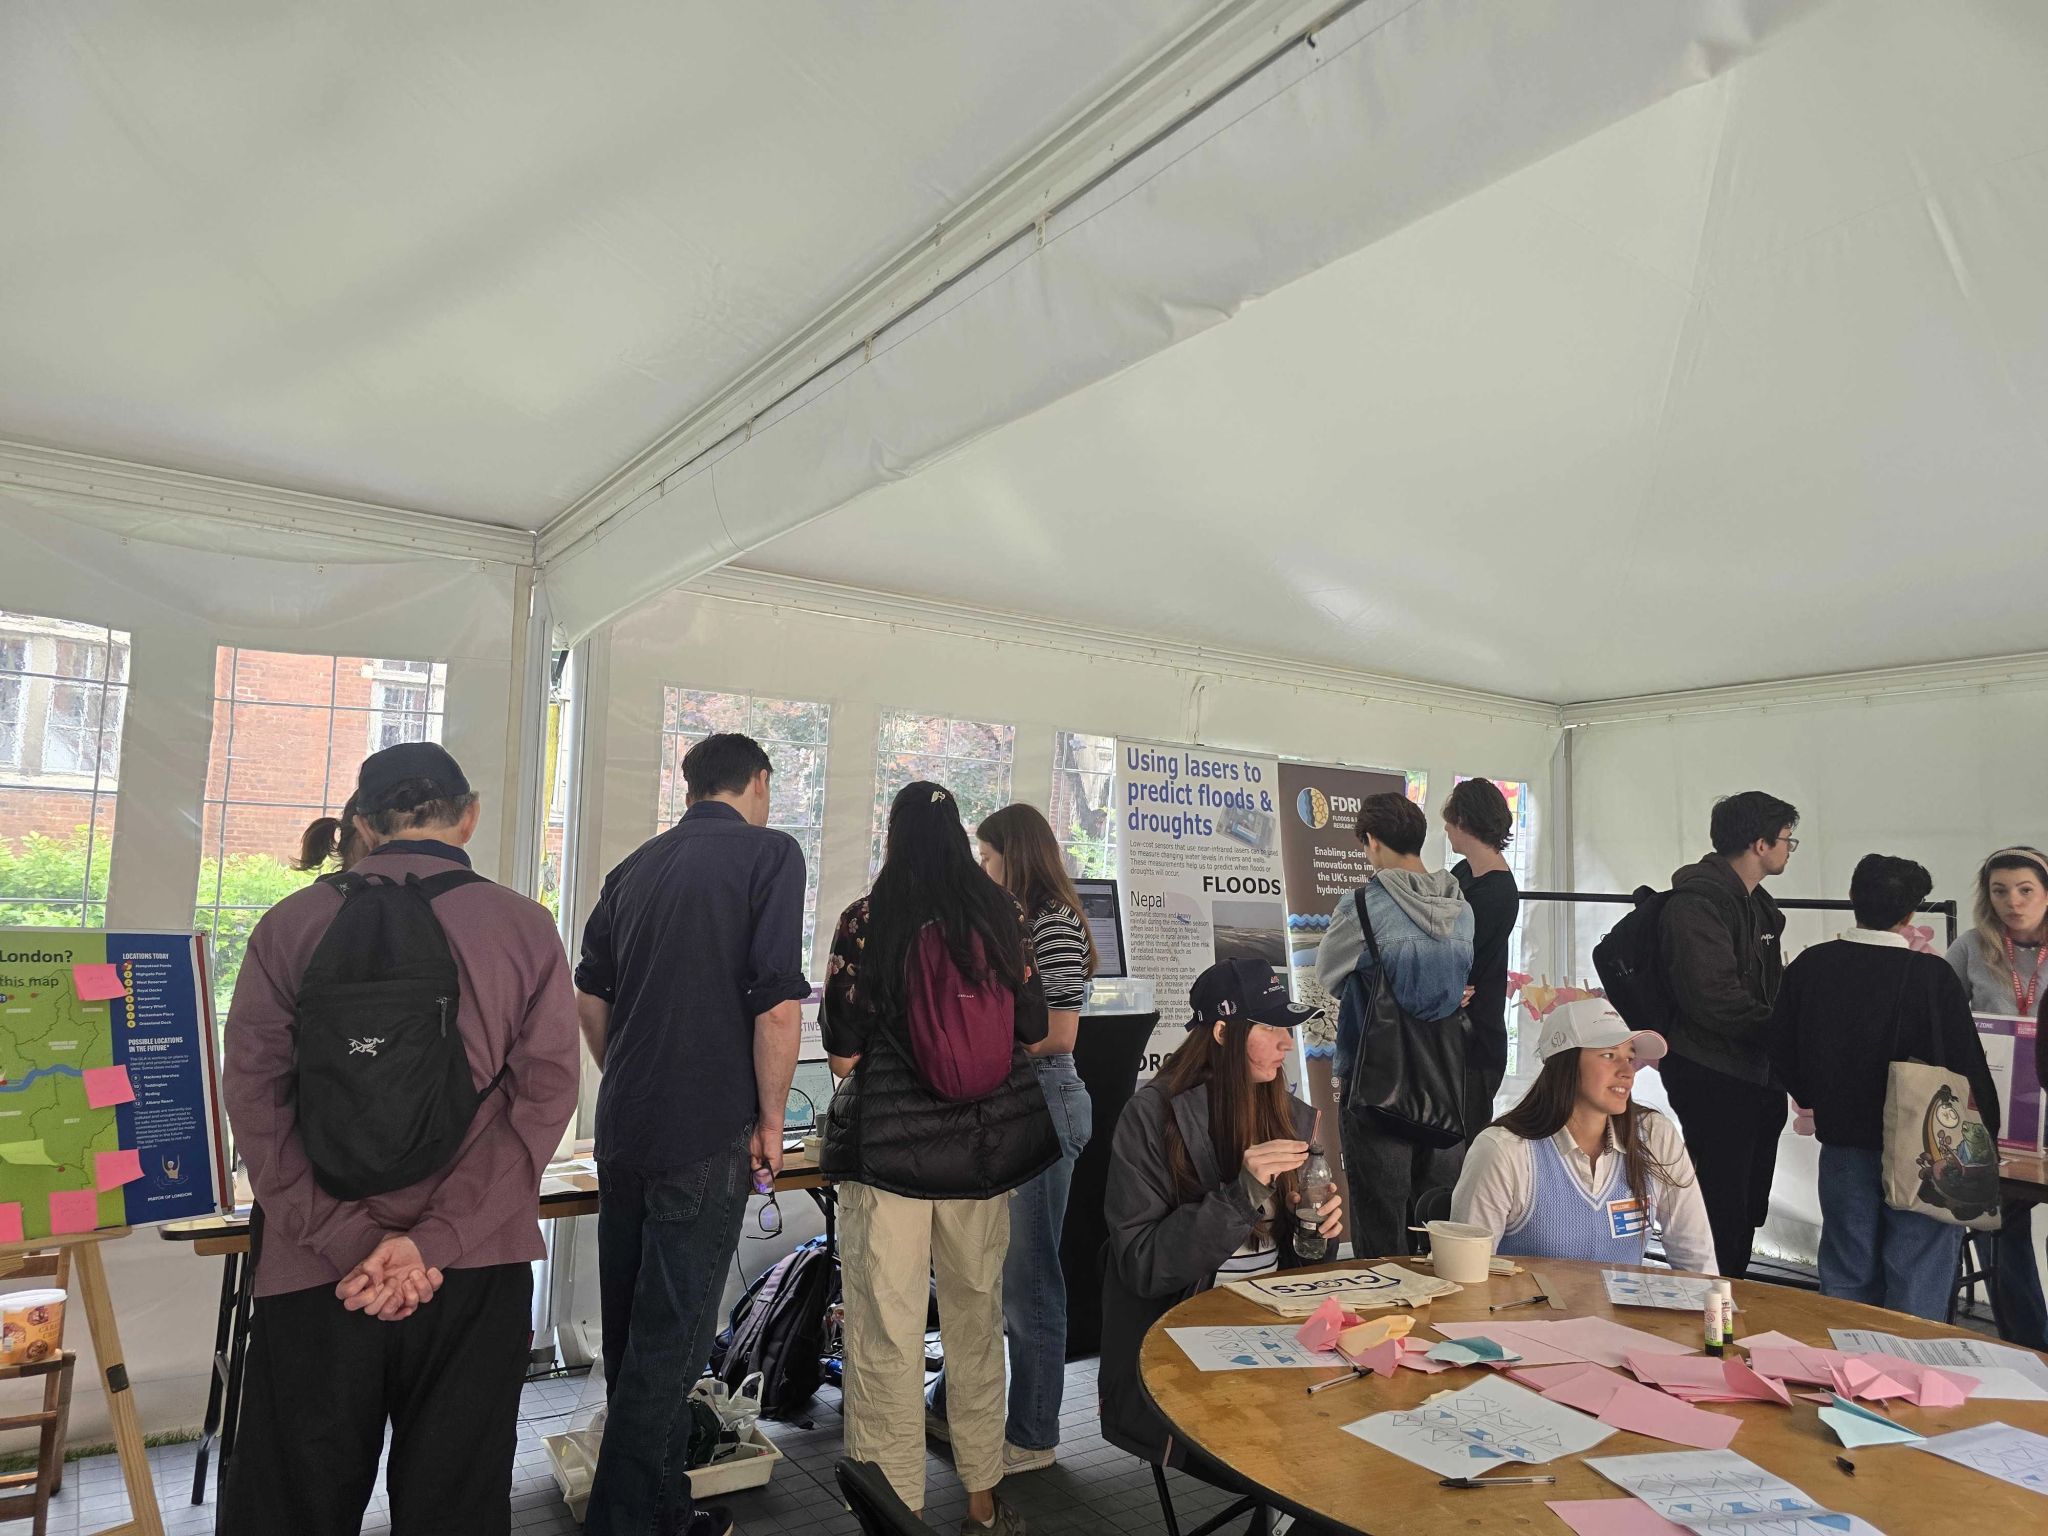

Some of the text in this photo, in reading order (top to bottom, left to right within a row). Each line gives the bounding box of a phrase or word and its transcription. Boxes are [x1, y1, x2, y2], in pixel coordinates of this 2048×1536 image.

[1127, 747, 1262, 783] Using lasers to
[1127, 780, 1274, 812] predict floods &
[1127, 807, 1213, 839] droughts
[1130, 840, 1154, 848] Low-cost
[1198, 845, 1233, 853] near-infrared
[1315, 846, 1367, 859] Enabling scien
[1161, 851, 1184, 860] changing
[1130, 858, 1146, 866] These
[1148, 860, 1185, 868] measurements
[1186, 861, 1198, 869] help
[1214, 863, 1233, 871] predict
[1250, 864, 1265, 872] floods
[1313, 859, 1352, 870] innovation
[1354, 862, 1362, 870] to
[1130, 867, 1154, 876] droughts
[1317, 872, 1370, 883] the UK's resili
[1203, 875, 1281, 896] FLOODS
[1130, 891, 1165, 911] Nepal
[1148, 918, 1161, 926] during
[0, 949, 73, 963] London?
[0, 975, 59, 988] this map
[1175, 1007, 1190, 1015] people
[1221, 1000, 1231, 1015] 1
[128, 1036, 183, 1046] POSSIBLE LOCATIONS
[128, 1045, 135, 1053] IN
[172, 1191, 192, 1199] LONDON
[1271, 1274, 1381, 1294] CLOCS
